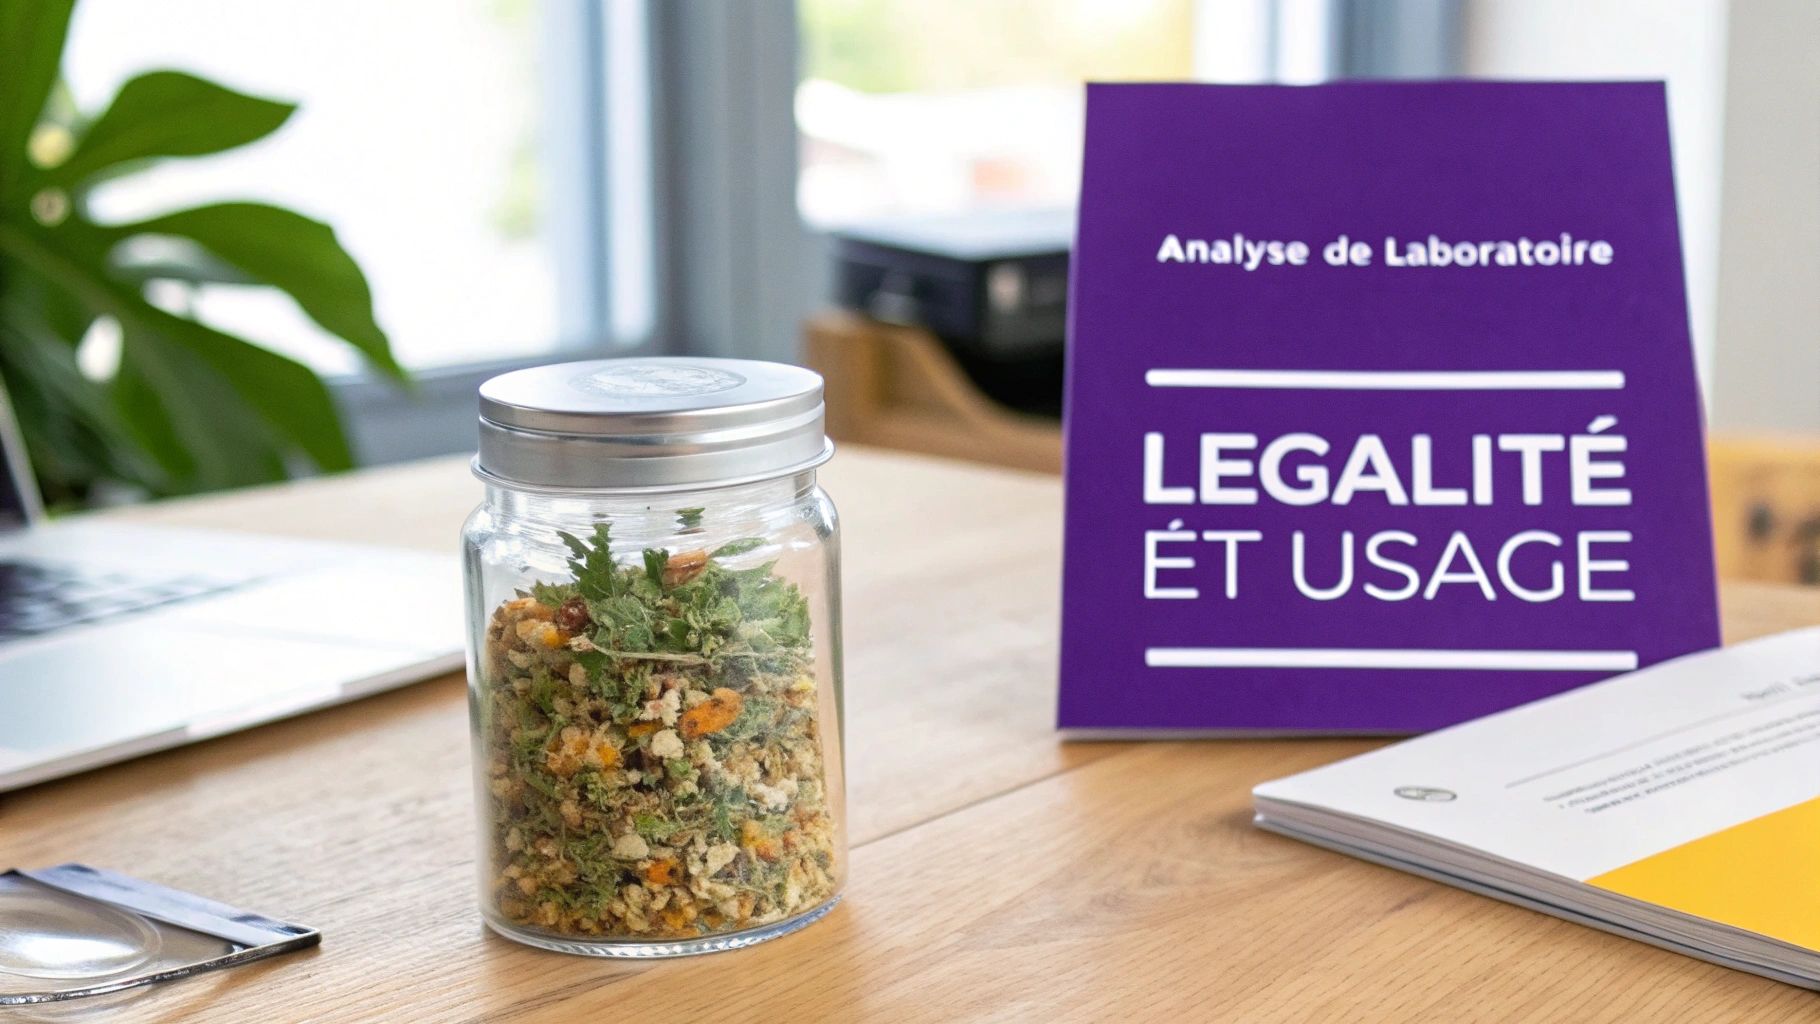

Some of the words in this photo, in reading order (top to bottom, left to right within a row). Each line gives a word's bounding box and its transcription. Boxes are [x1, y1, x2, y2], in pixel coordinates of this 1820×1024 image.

[1156, 233, 1309, 271] Analyse
[1323, 236, 1372, 266] de
[1385, 233, 1614, 267] Laboratoire
[1143, 416, 1632, 506] LEGALITÉ
[1144, 519, 1263, 600] ÉT
[1292, 530, 1635, 602] USAGE
